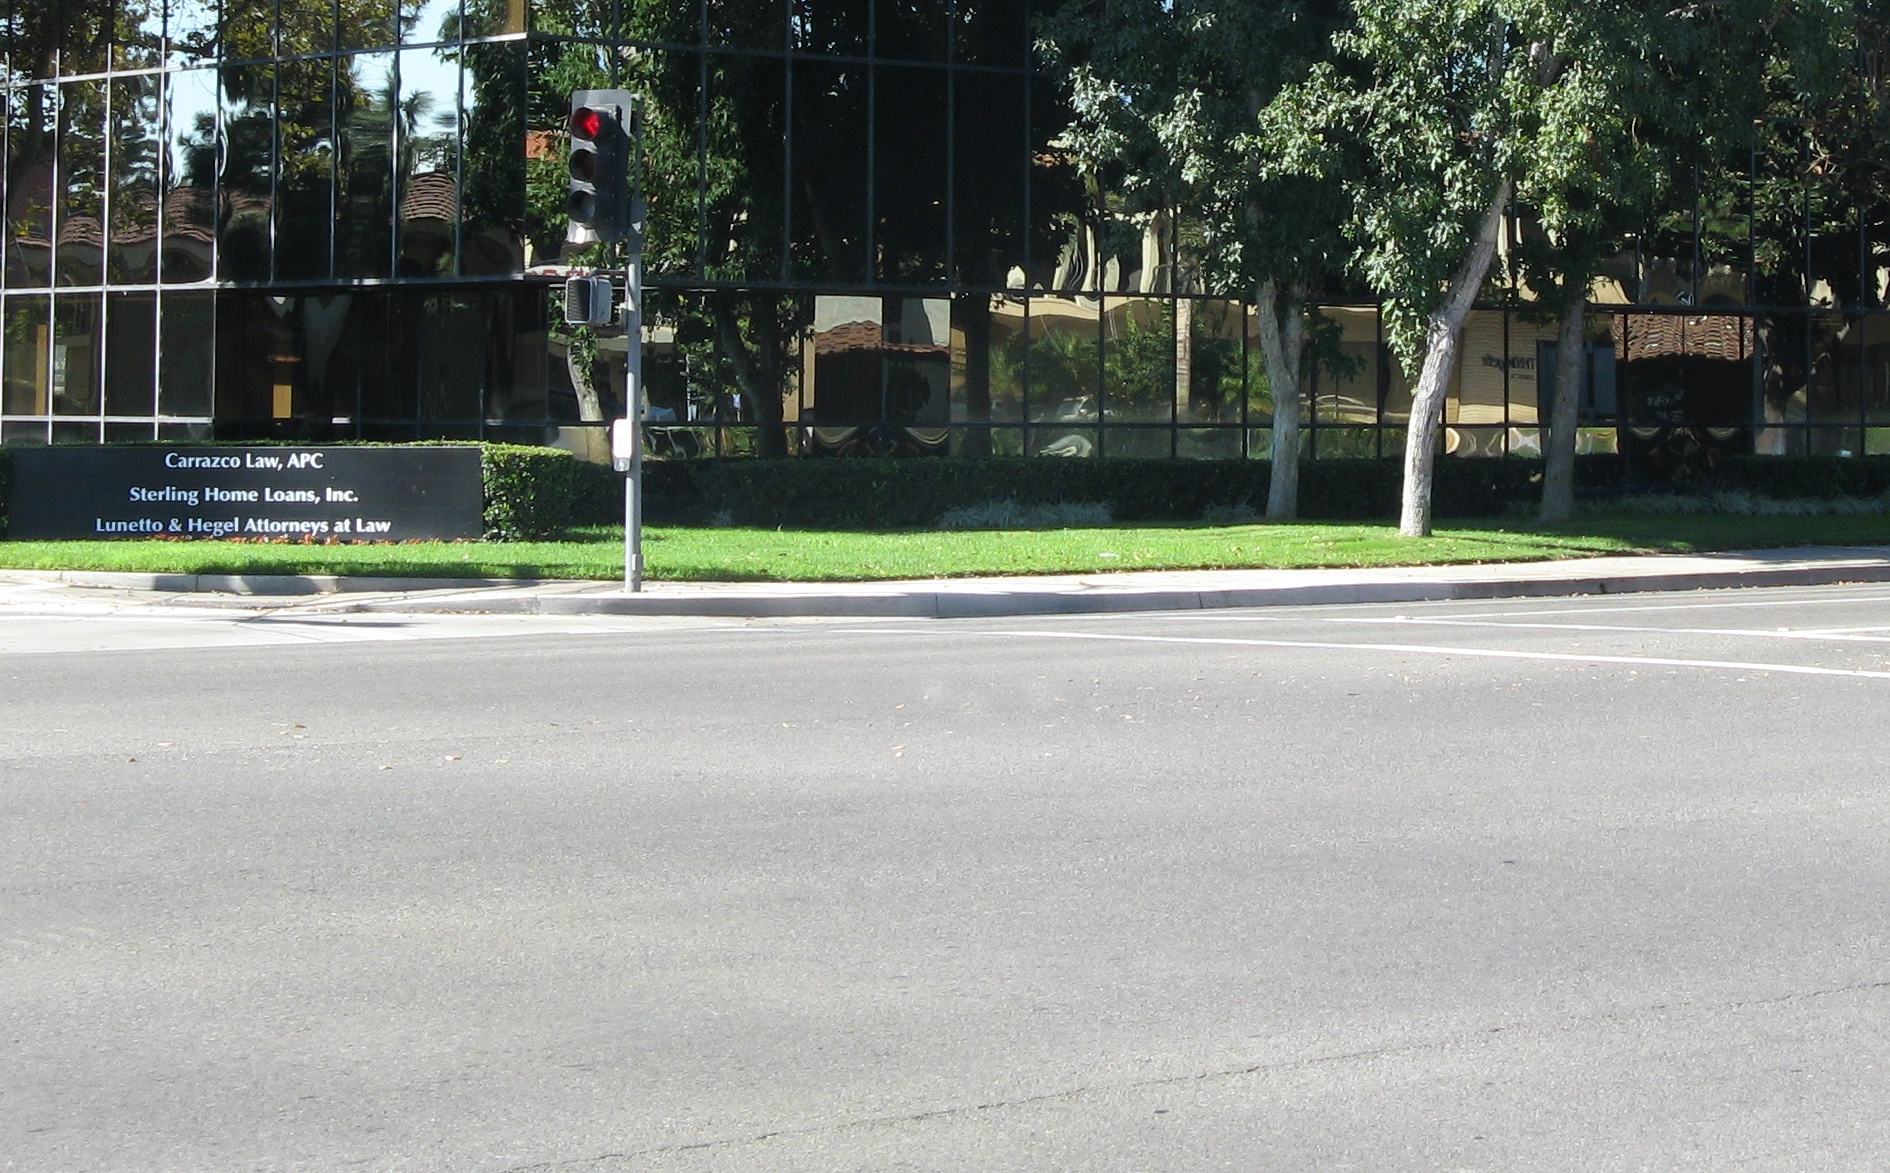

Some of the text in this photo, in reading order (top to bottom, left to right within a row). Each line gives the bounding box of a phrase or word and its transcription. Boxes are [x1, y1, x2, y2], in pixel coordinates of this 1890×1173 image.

[165, 452, 324, 472] Carrazco Law, APC
[129, 486, 359, 506] Sterling Home Loans, Inc.
[95, 517, 392, 536] Lunetto & Hegel Attorneys at Law
